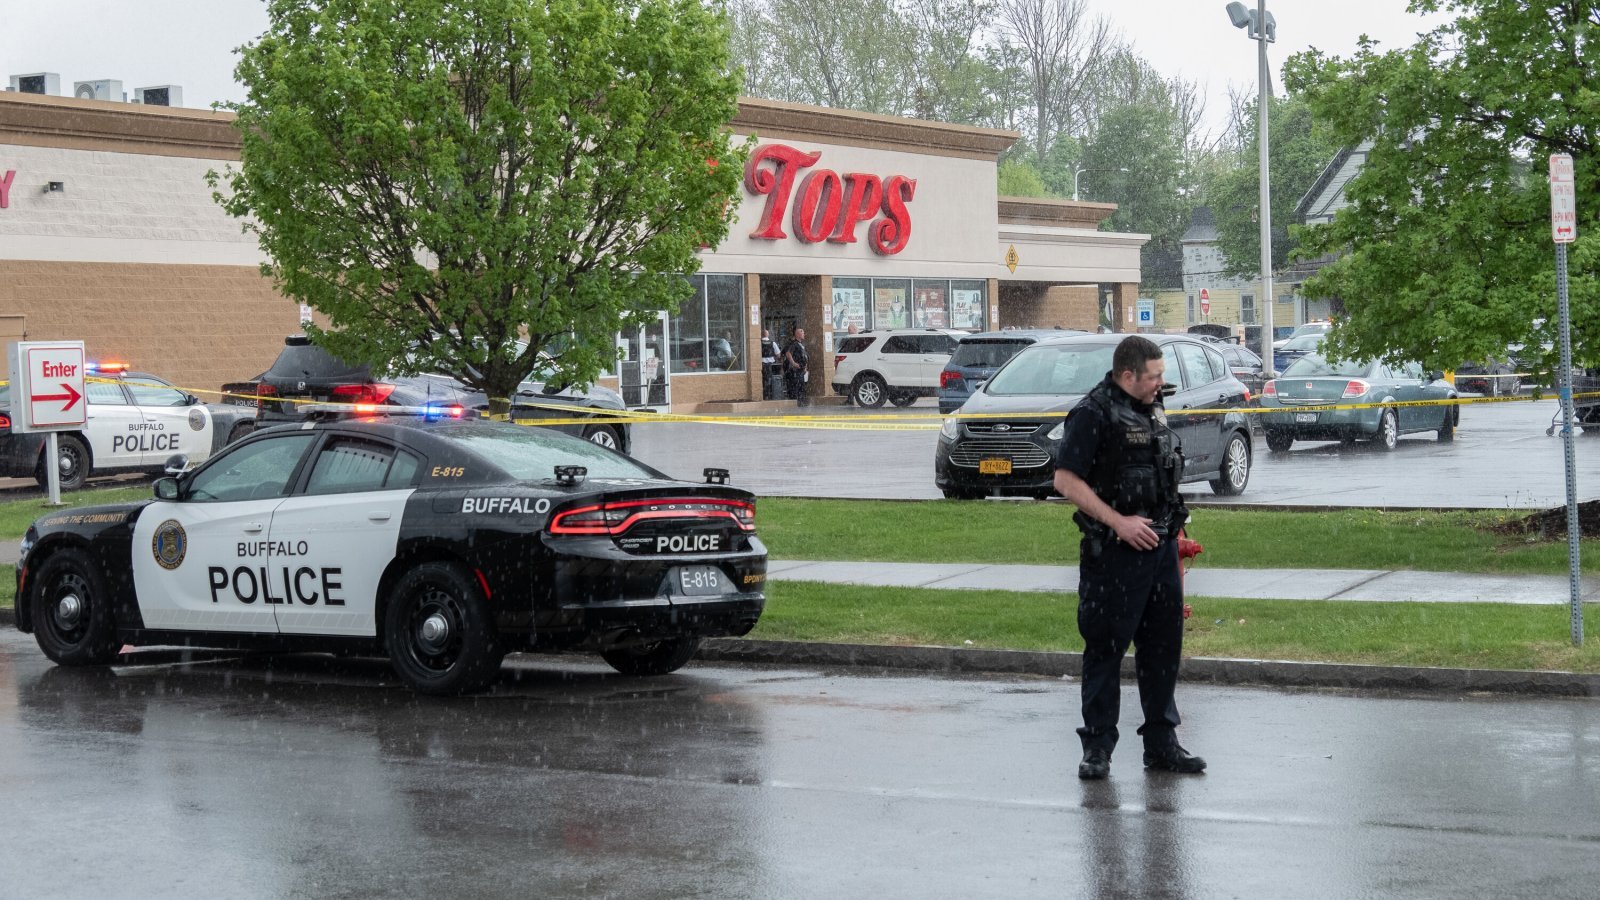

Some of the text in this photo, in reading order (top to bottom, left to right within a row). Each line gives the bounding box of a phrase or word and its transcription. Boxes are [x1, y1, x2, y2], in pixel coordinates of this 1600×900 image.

[42, 361, 77, 378] Enter
[128, 422, 164, 431] BUFFALO
[113, 433, 180, 453] POLICE
[431, 466, 465, 477] E-815
[461, 497, 550, 514] BUFFALO
[69, 515, 84, 524] THE
[84, 513, 127, 523] COMMUNITY
[237, 540, 309, 557] BUFFALO
[656, 534, 720, 553] POLICE
[208, 566, 346, 606] POLICE
[681, 571, 718, 588] E-815
